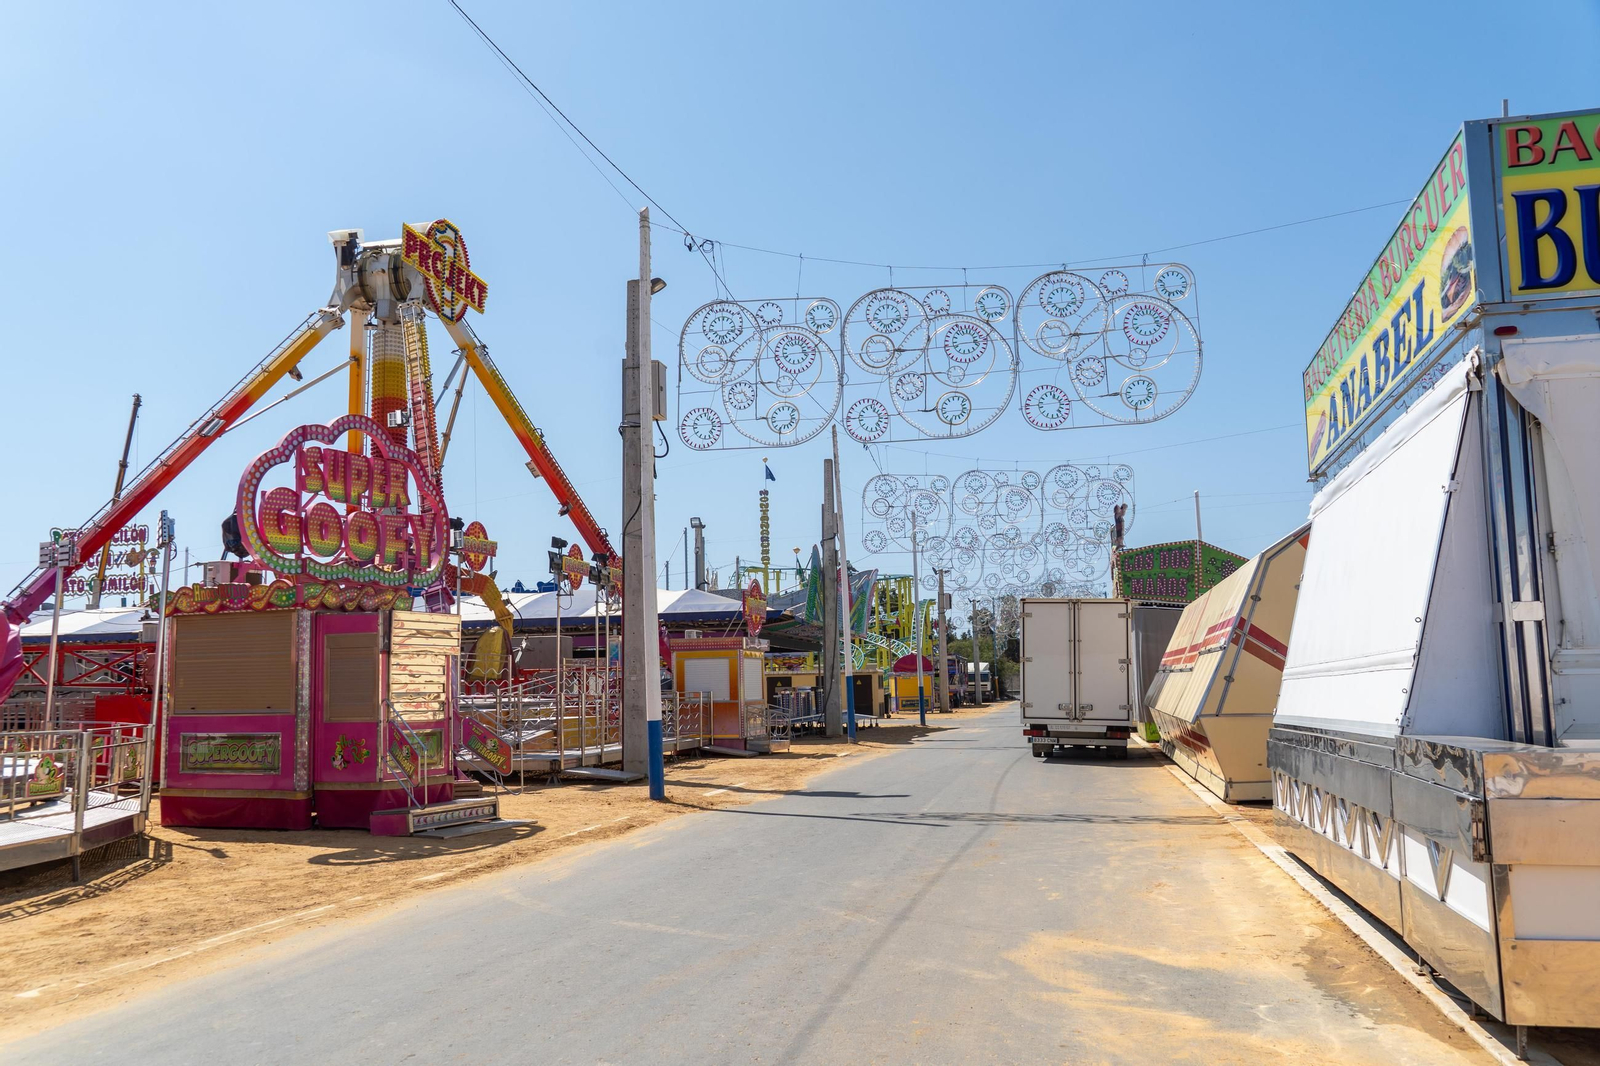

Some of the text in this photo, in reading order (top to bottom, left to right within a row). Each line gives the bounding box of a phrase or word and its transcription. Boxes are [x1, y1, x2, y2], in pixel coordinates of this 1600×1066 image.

[1505, 120, 1600, 169] BA
[1378, 141, 1466, 300] BURGUER
[1326, 276, 1434, 451] ANABEL
[302, 446, 412, 508] SUPER
[259, 486, 436, 569] GOOFY
[1124, 547, 1192, 573] LOS DOS
[1130, 572, 1188, 598] MAÑOS
[188, 740, 276, 764] SUPERGOOFY
